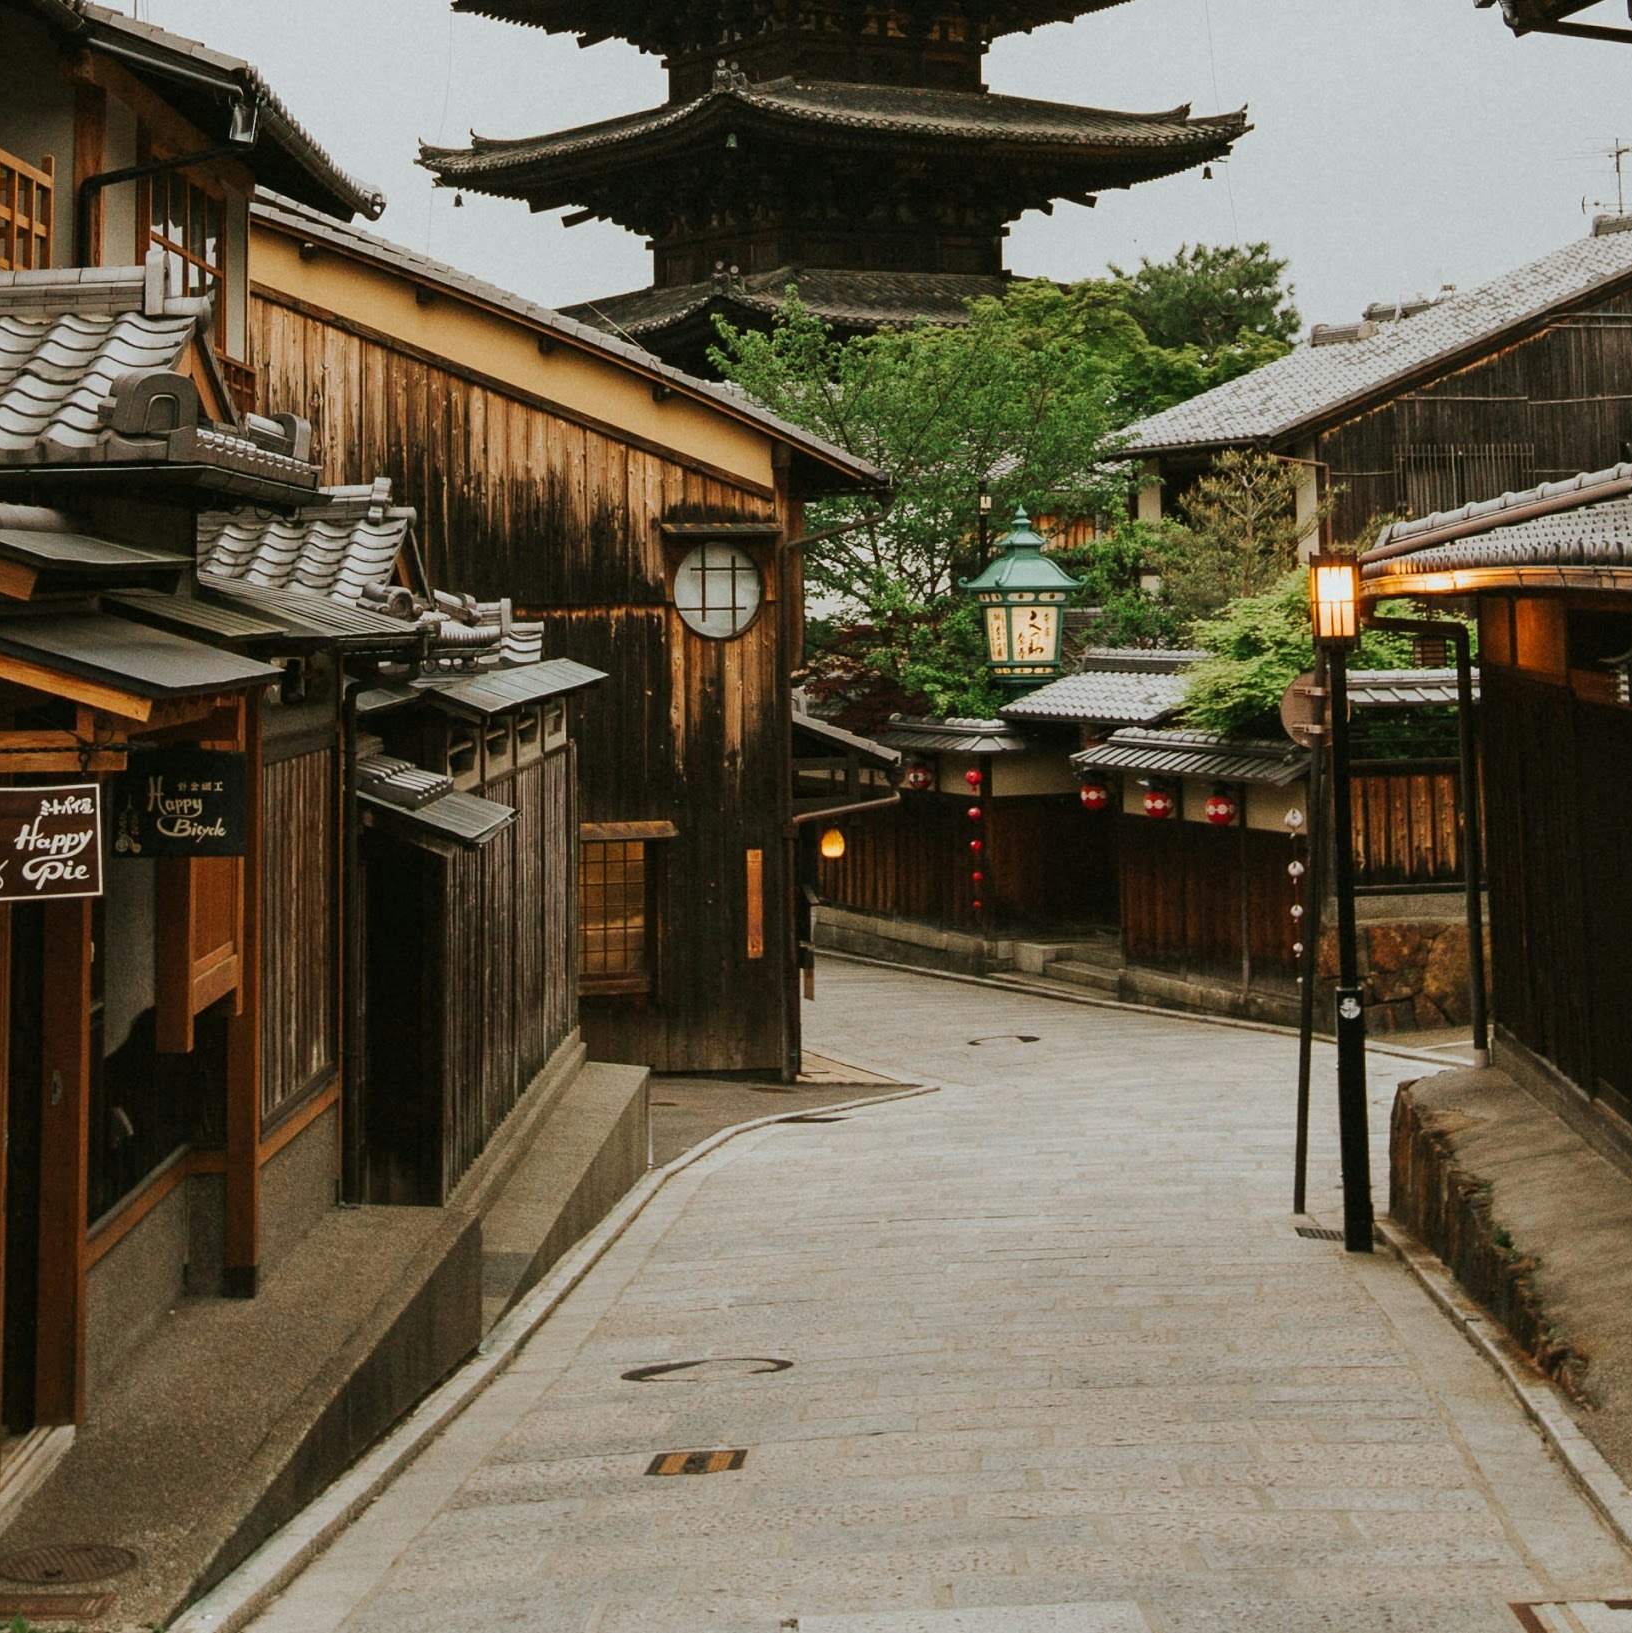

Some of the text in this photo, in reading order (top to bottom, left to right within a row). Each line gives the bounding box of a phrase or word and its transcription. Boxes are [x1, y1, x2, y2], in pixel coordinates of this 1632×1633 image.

[39, 795, 95, 816] ミートパイ屋
[148, 775, 202, 818] Happy
[13, 815, 94, 858] Happy
[156, 817, 227, 843] Bicycle
[22, 859, 90, 891] Pie
